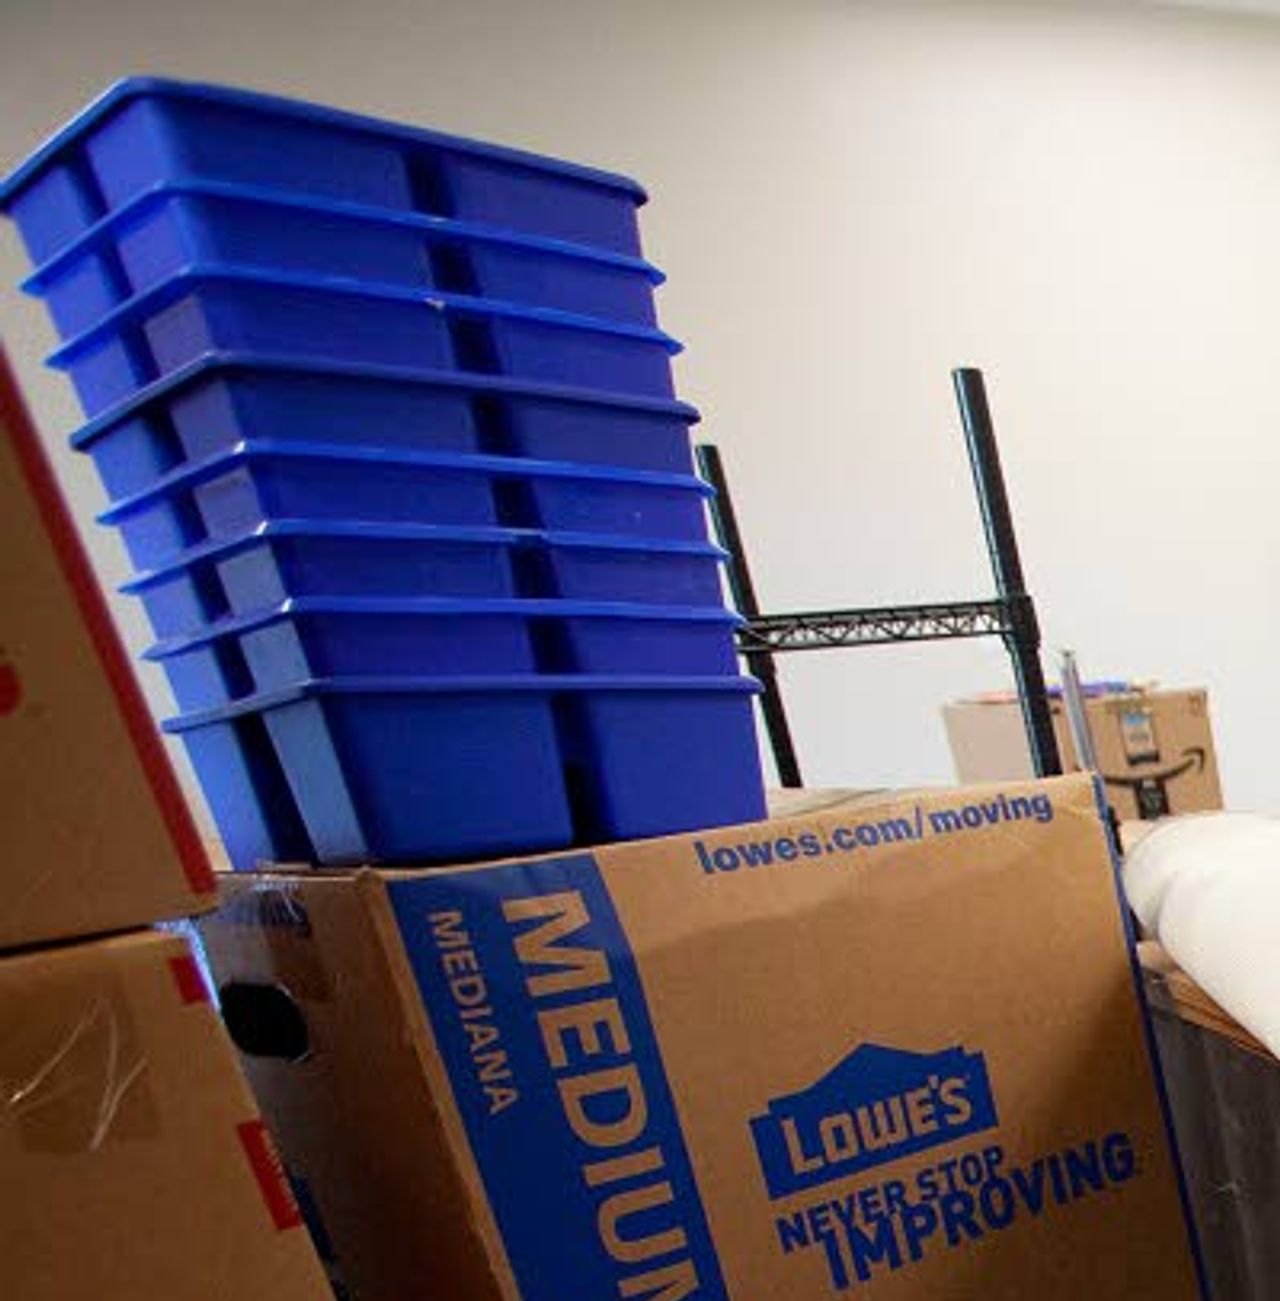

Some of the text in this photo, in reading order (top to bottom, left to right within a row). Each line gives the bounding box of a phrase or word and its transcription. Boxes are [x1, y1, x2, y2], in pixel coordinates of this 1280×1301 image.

[694, 792, 1053, 874] lowes.com/moving
[427, 909, 520, 1114] MEDIANA
[781, 1074, 975, 1177] LOWE'S
[776, 1146, 1004, 1255] NEVER STOP
[822, 1132, 1136, 1292] IMPROVING
